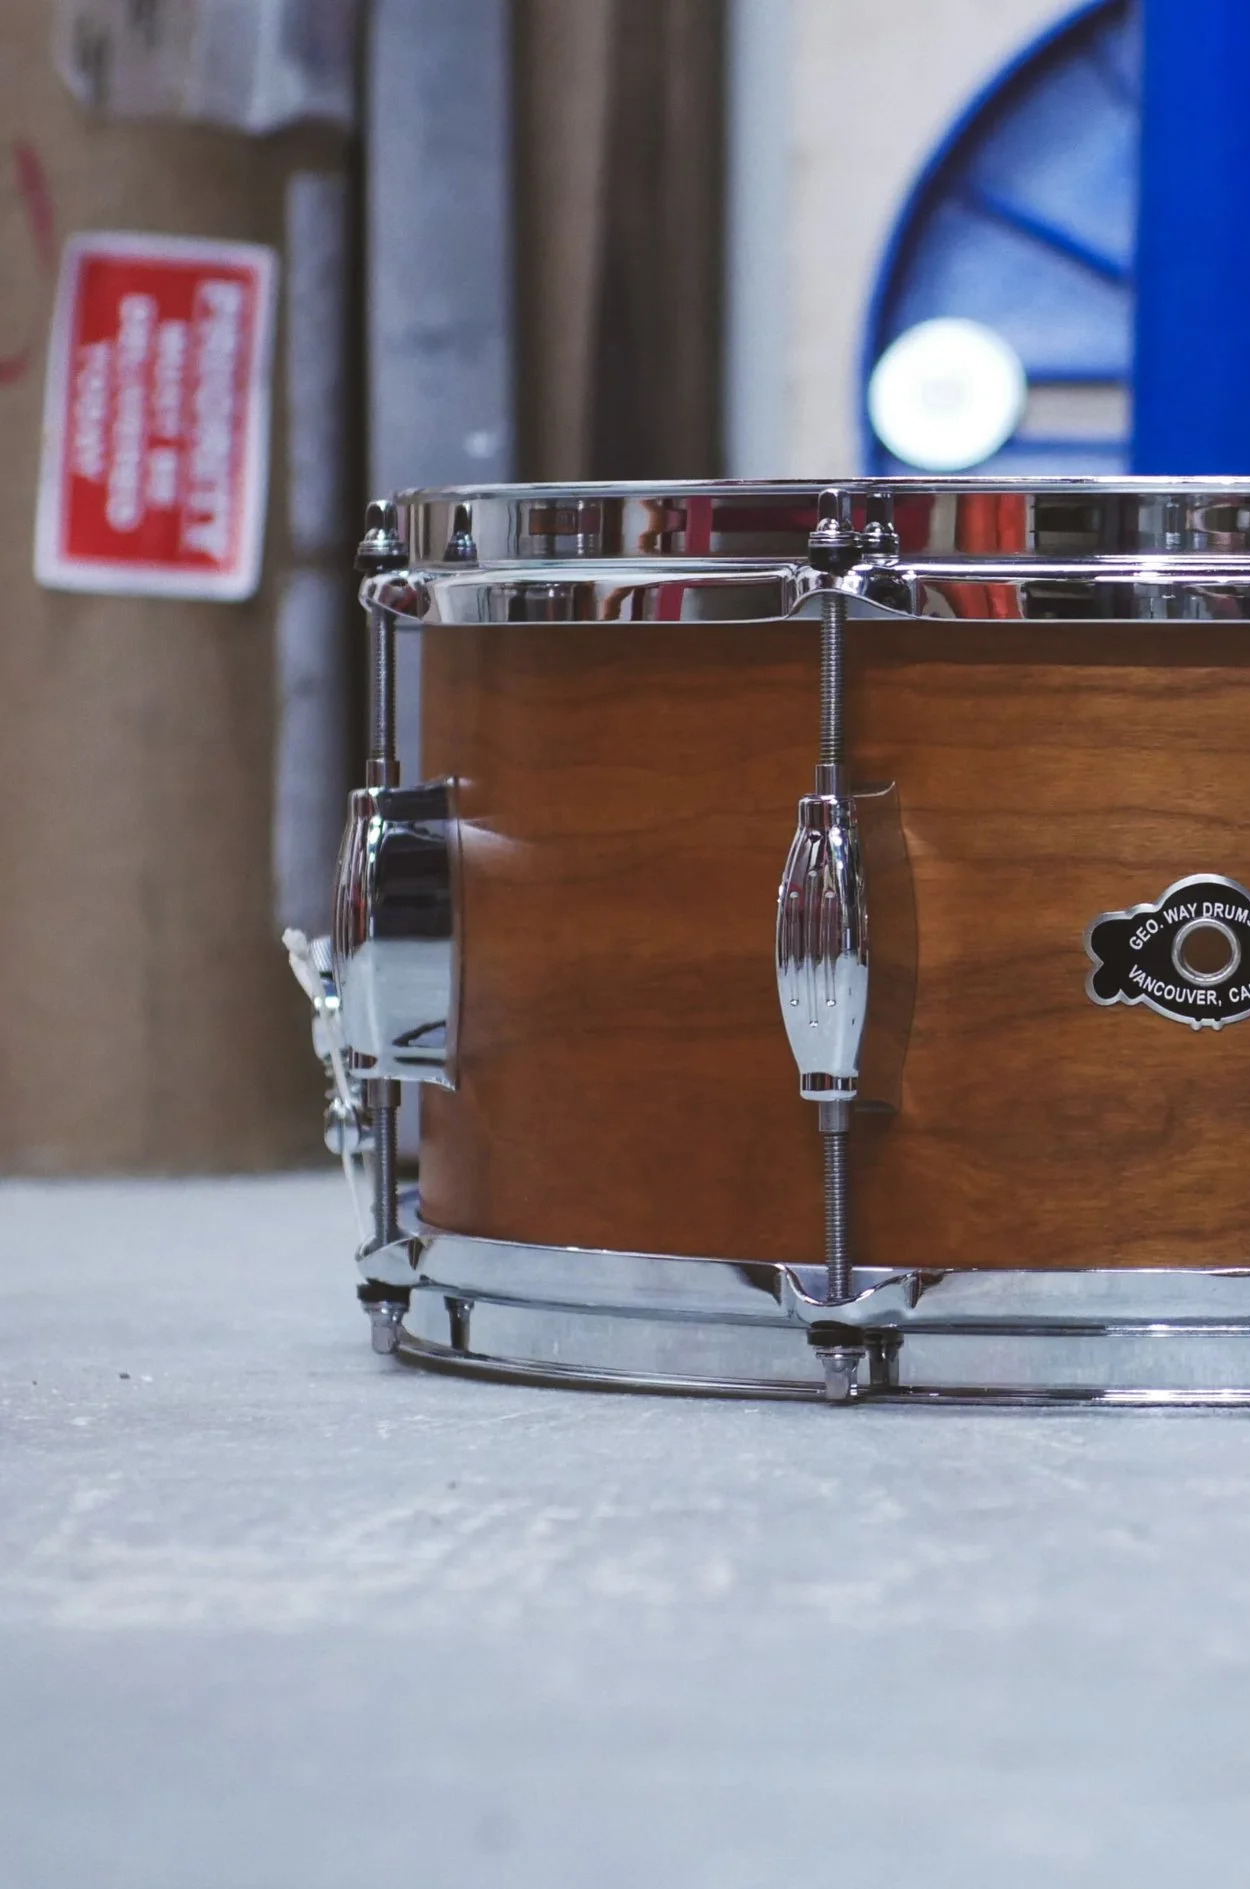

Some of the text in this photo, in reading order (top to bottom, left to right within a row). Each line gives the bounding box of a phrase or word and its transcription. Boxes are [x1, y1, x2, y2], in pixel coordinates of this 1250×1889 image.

[1129, 919, 1164, 950] GEO.
[1164, 902, 1197, 925] WAY
[1128, 964, 1221, 1006] VANCOUVER,
